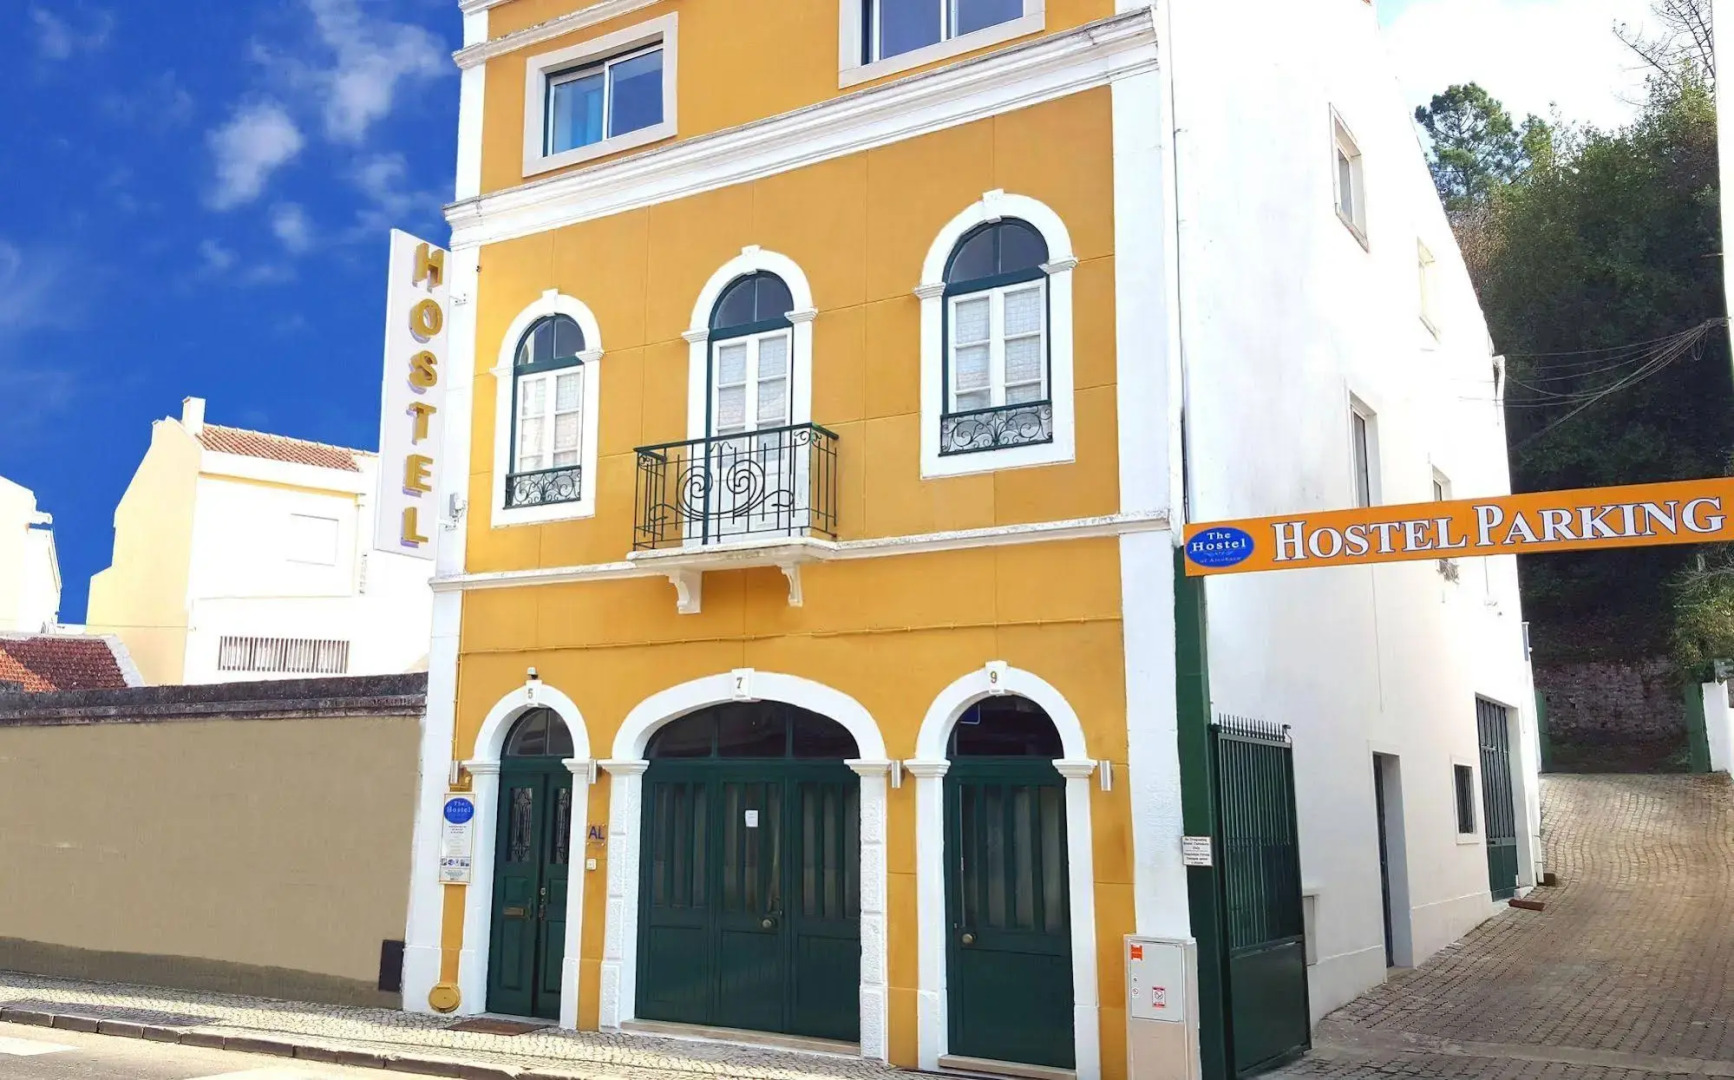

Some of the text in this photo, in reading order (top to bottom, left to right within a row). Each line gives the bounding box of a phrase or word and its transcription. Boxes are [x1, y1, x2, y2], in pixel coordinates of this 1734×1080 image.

[402, 242, 444, 543] HOSTEL
[1271, 496, 1727, 562] HOSTEL PARKING
[1206, 532, 1231, 540] The
[1192, 538, 1246, 551] Hostel
[736, 677, 743, 689] 7
[990, 671, 997, 684] 9
[527, 688, 533, 699] 5
[588, 826, 605, 839] AL
